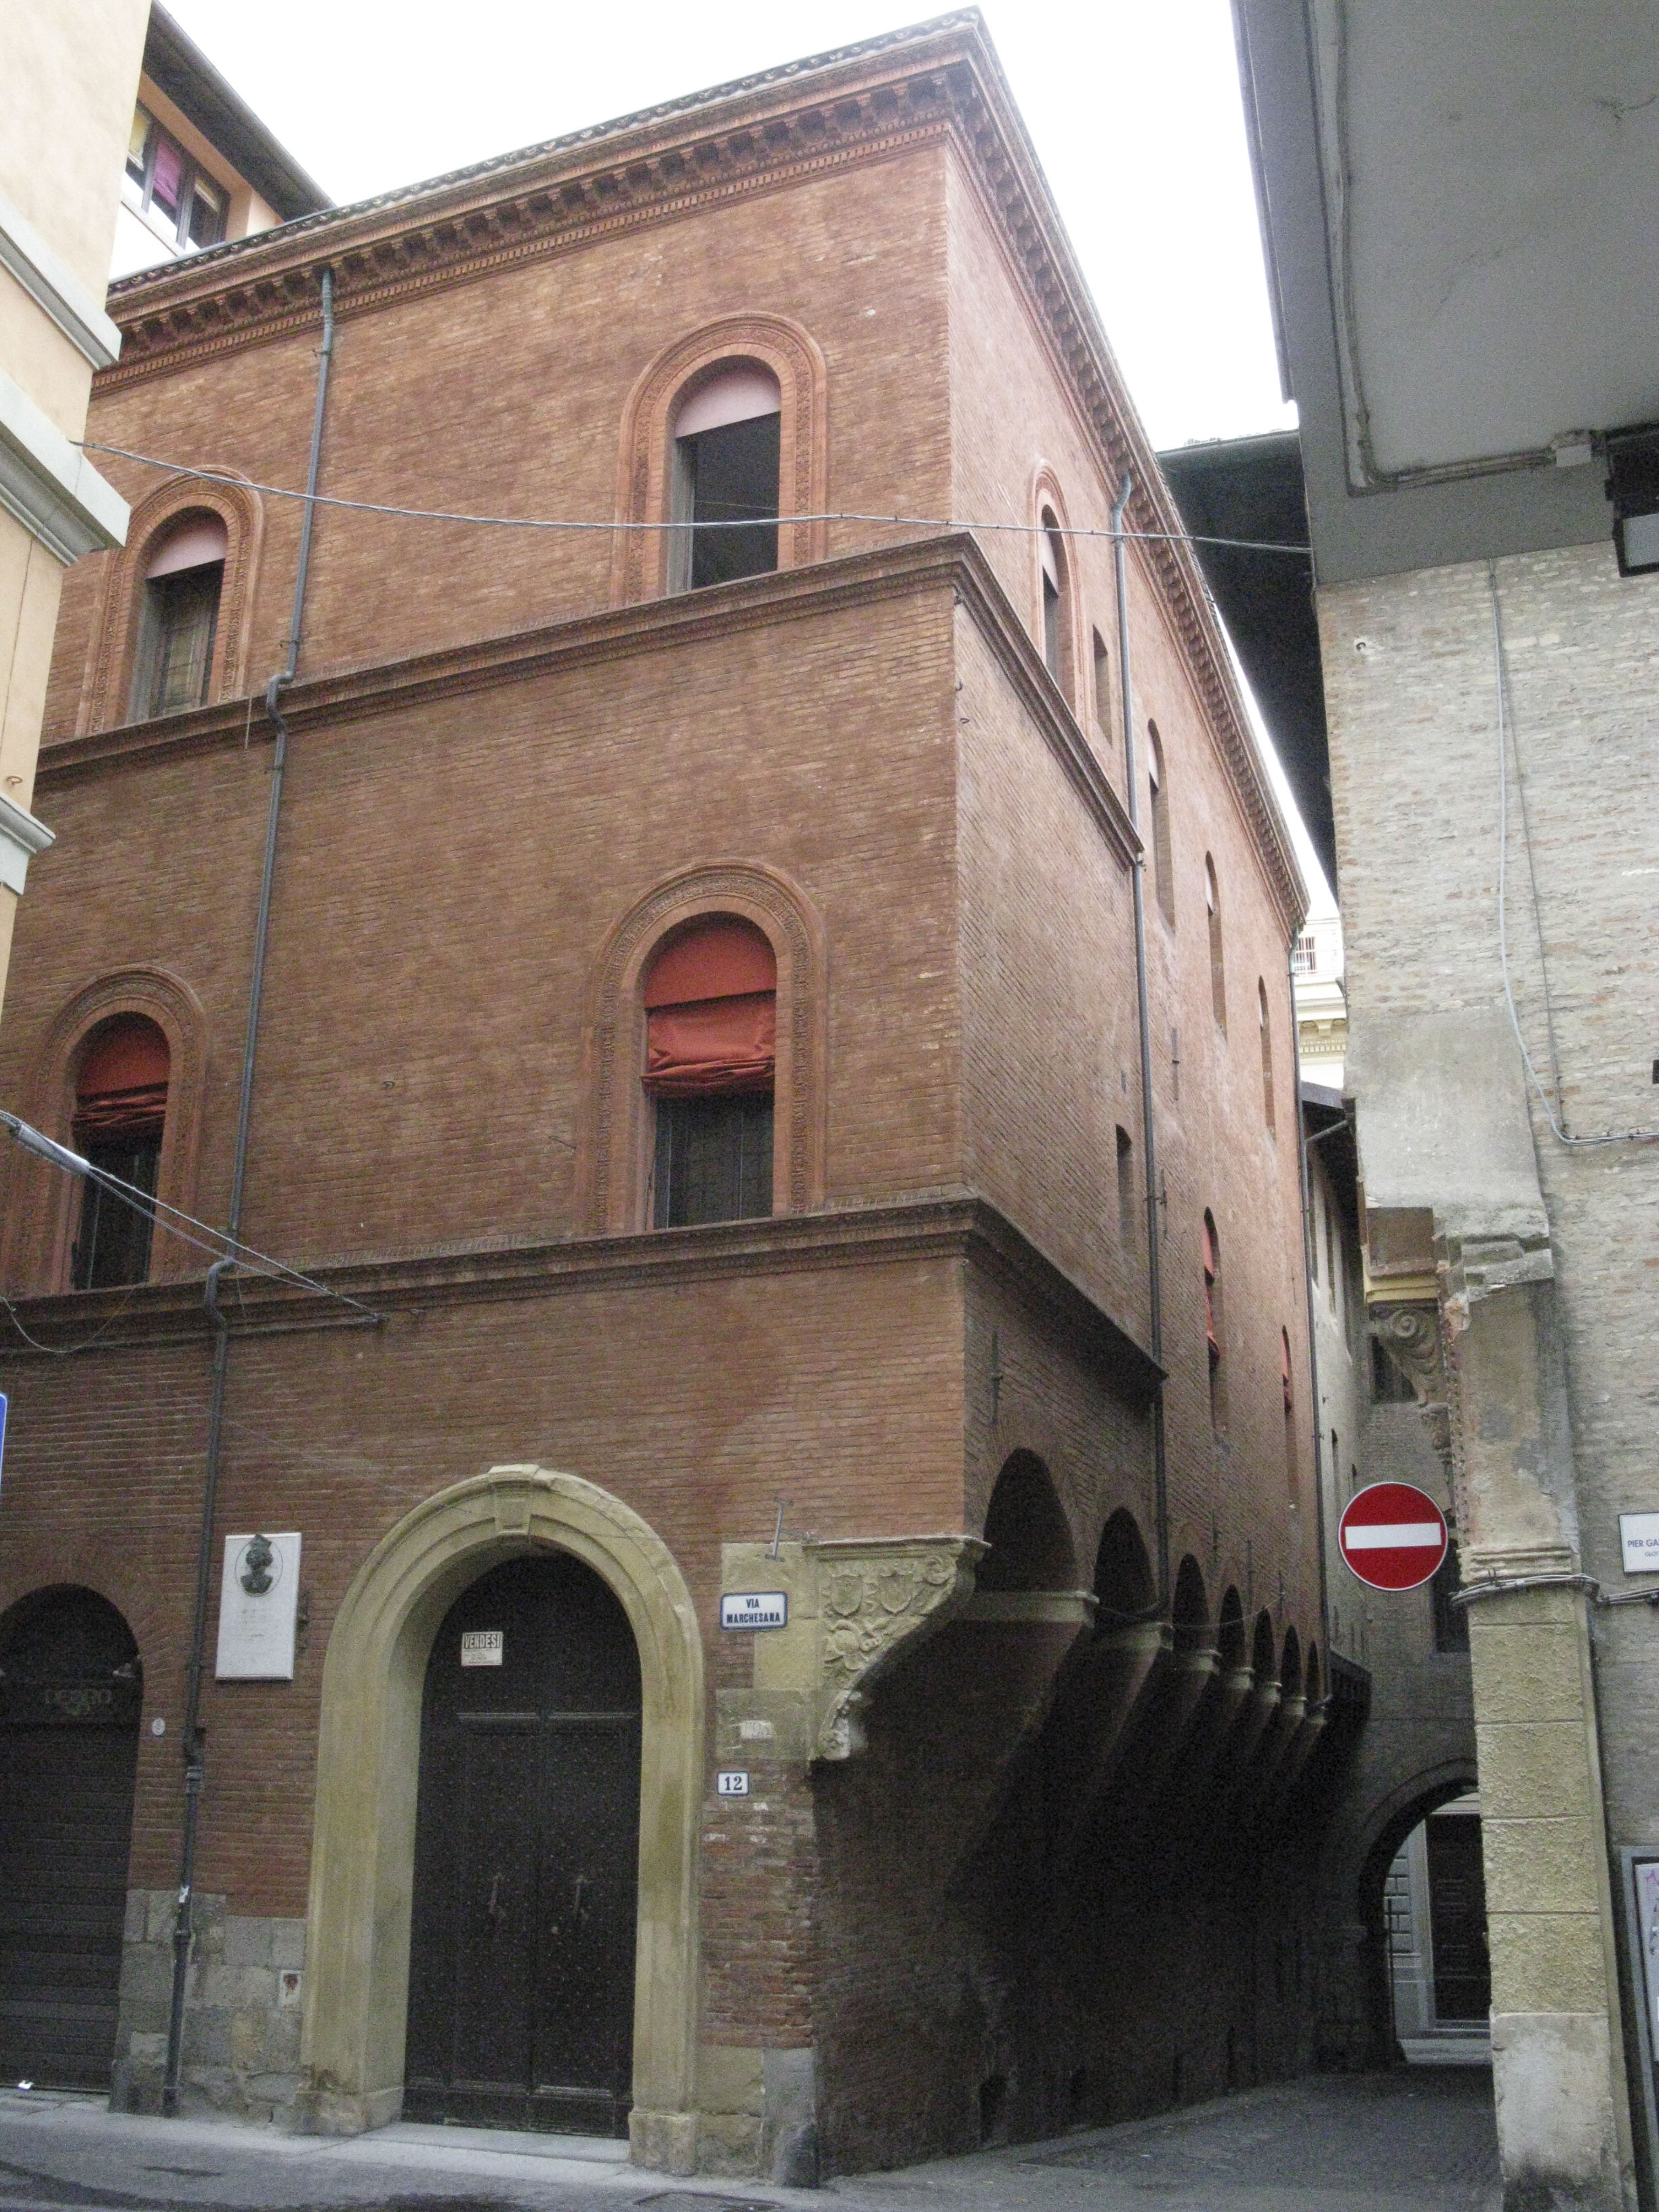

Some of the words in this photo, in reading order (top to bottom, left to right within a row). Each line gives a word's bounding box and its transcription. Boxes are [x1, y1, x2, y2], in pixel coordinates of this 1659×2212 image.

[1646, 1538, 1659, 1547] GA
[746, 1599, 759, 1608] VIA
[726, 1612, 780, 1624] MARCHESANA
[465, 1634, 501, 1649] VENDESI
[724, 1776, 743, 1790] 12
